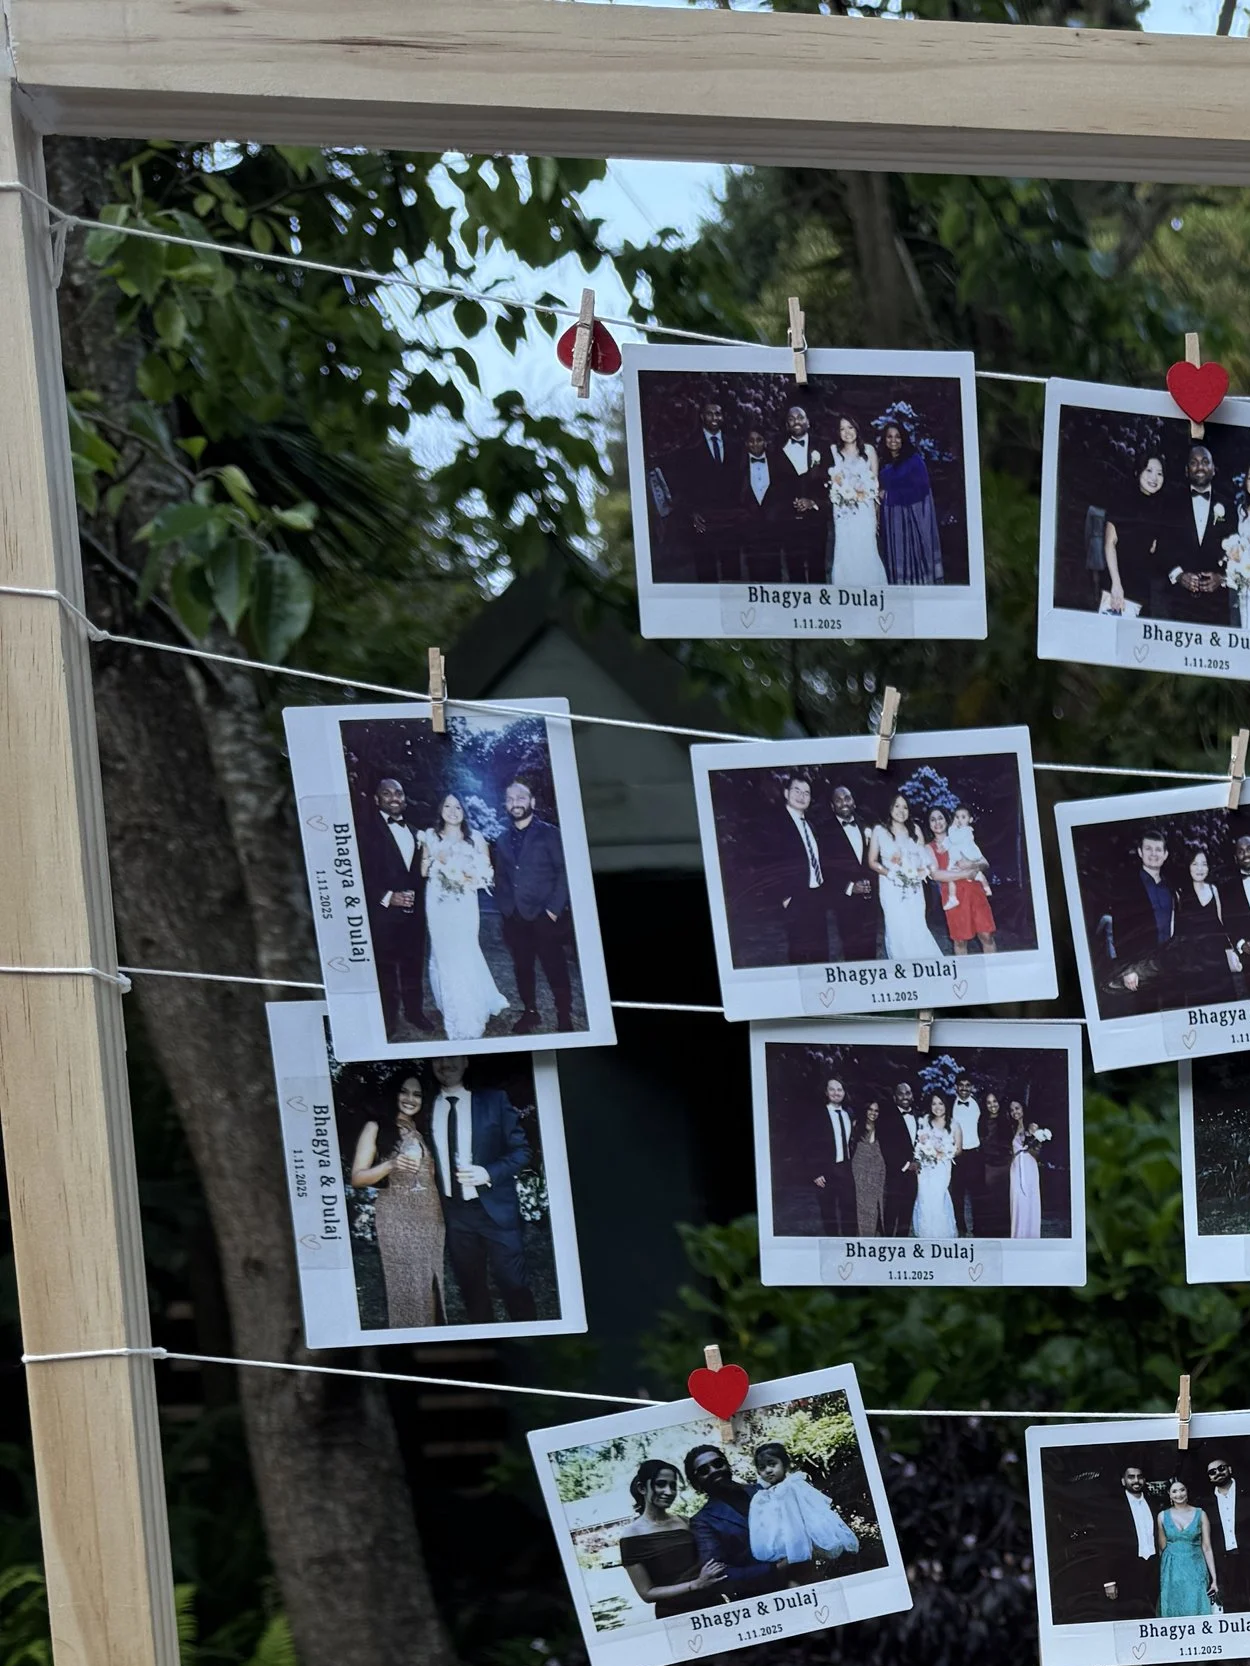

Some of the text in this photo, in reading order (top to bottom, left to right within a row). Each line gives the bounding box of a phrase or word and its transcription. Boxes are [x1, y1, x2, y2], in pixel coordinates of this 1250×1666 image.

[748, 586, 885, 610] Bhagya & Dulaj
[794, 618, 842, 630] 1.11.2025
[1143, 624, 1202, 647] Bhagya
[1210, 632, 1222, 648] &
[1184, 656, 1230, 670] 1.11.2025
[316, 870, 333, 920] 1.11.2025
[333, 823, 370, 964] Bhagya & Dulaj
[826, 960, 958, 985] Bhagya & Dulaj
[872, 991, 918, 1004] 1.11.2025
[1188, 1007, 1246, 1027] Bhagya
[292, 1149, 308, 1198] 1.11.2025
[312, 1104, 342, 1240] Bhagya & Dulaj
[846, 1242, 975, 1262] Bhagya & Dulaj
[888, 1270, 934, 1281] 1.11.2025
[690, 1588, 818, 1630] Bhagya & Dulaj
[738, 1624, 783, 1642] 1.11.2025
[1139, 1623, 1196, 1640] Bhagya
[1202, 1621, 1214, 1635] &
[1180, 1645, 1222, 1656] 1.11.2025
